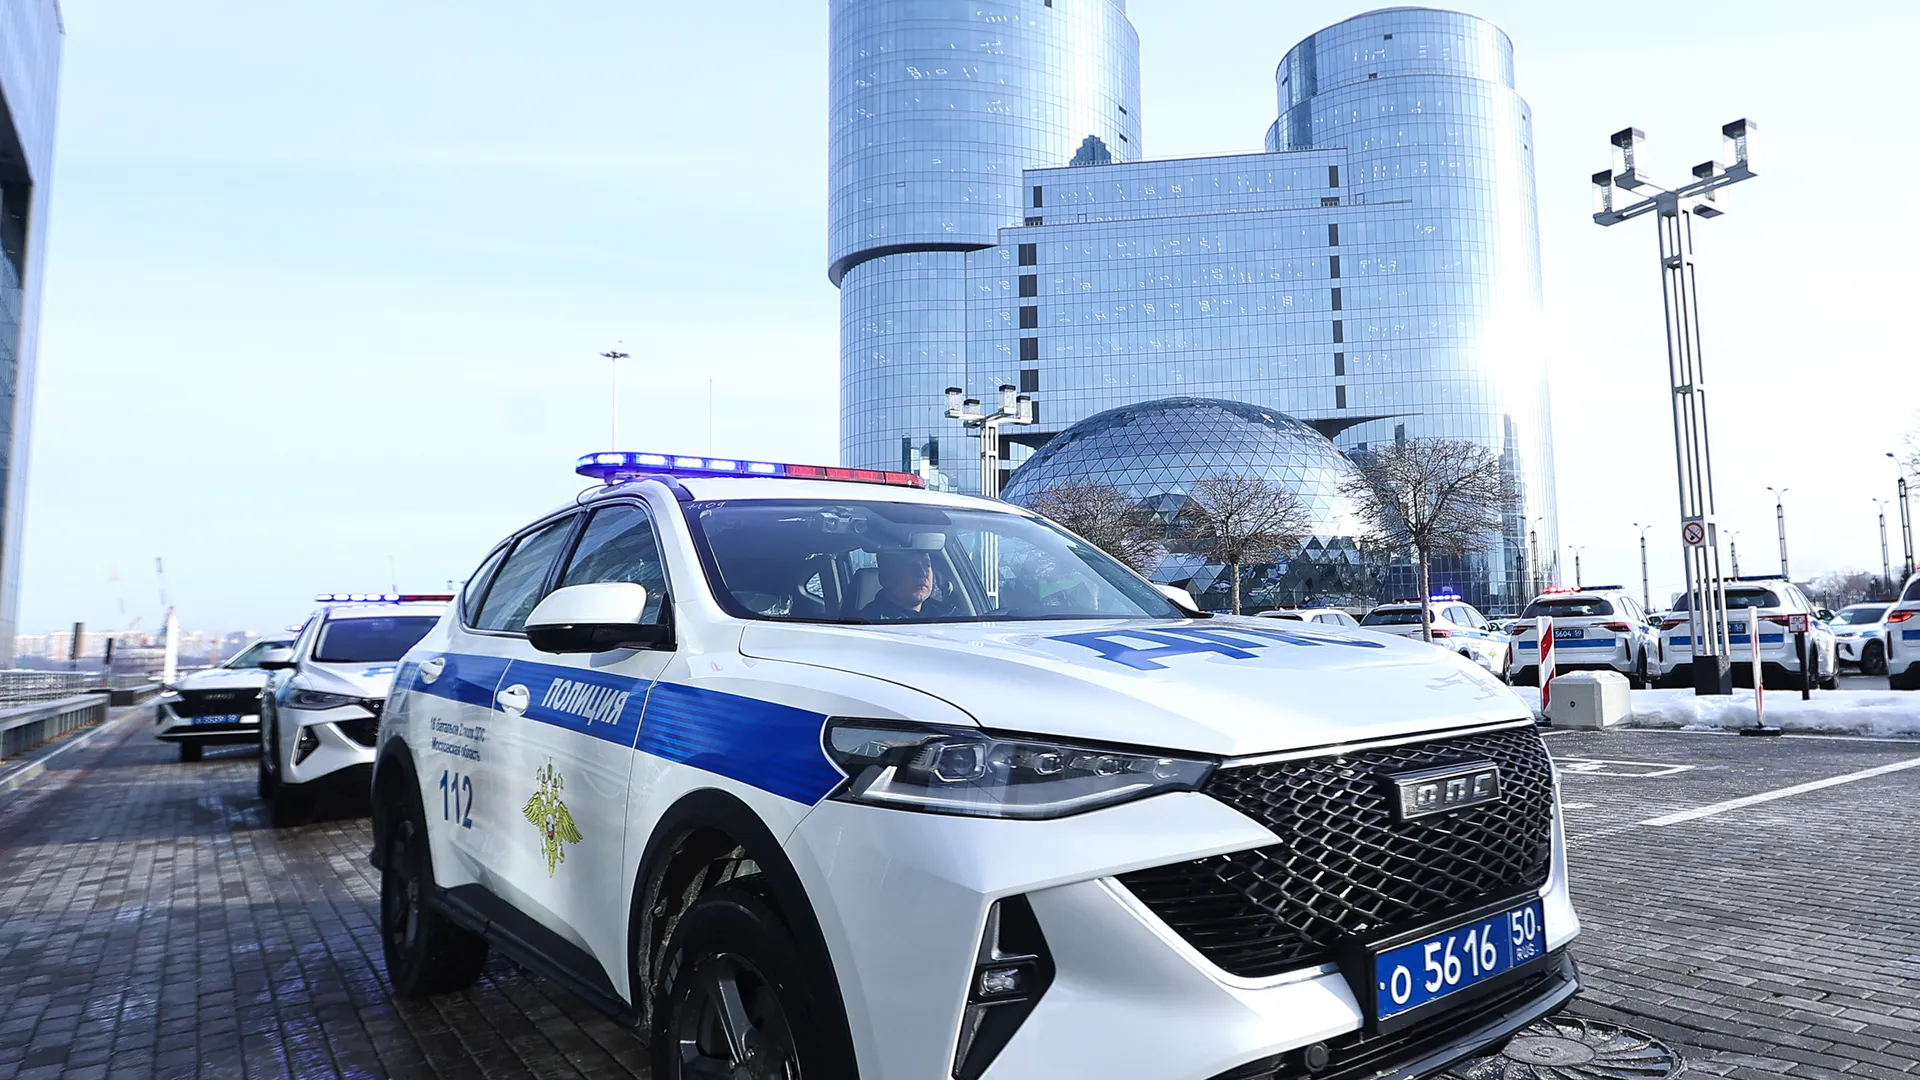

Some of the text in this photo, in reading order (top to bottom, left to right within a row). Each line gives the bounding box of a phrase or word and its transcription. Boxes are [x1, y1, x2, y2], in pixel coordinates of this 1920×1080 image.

[541, 677, 630, 725] ПОЛИЦИЯ
[436, 718, 459, 735] батальон
[431, 737, 481, 762] Московская область
[440, 769, 473, 830] 112
[1424, 924, 1497, 993] 5616
[1511, 907, 1536, 946] 50
[1516, 943, 1536, 961] RUS
